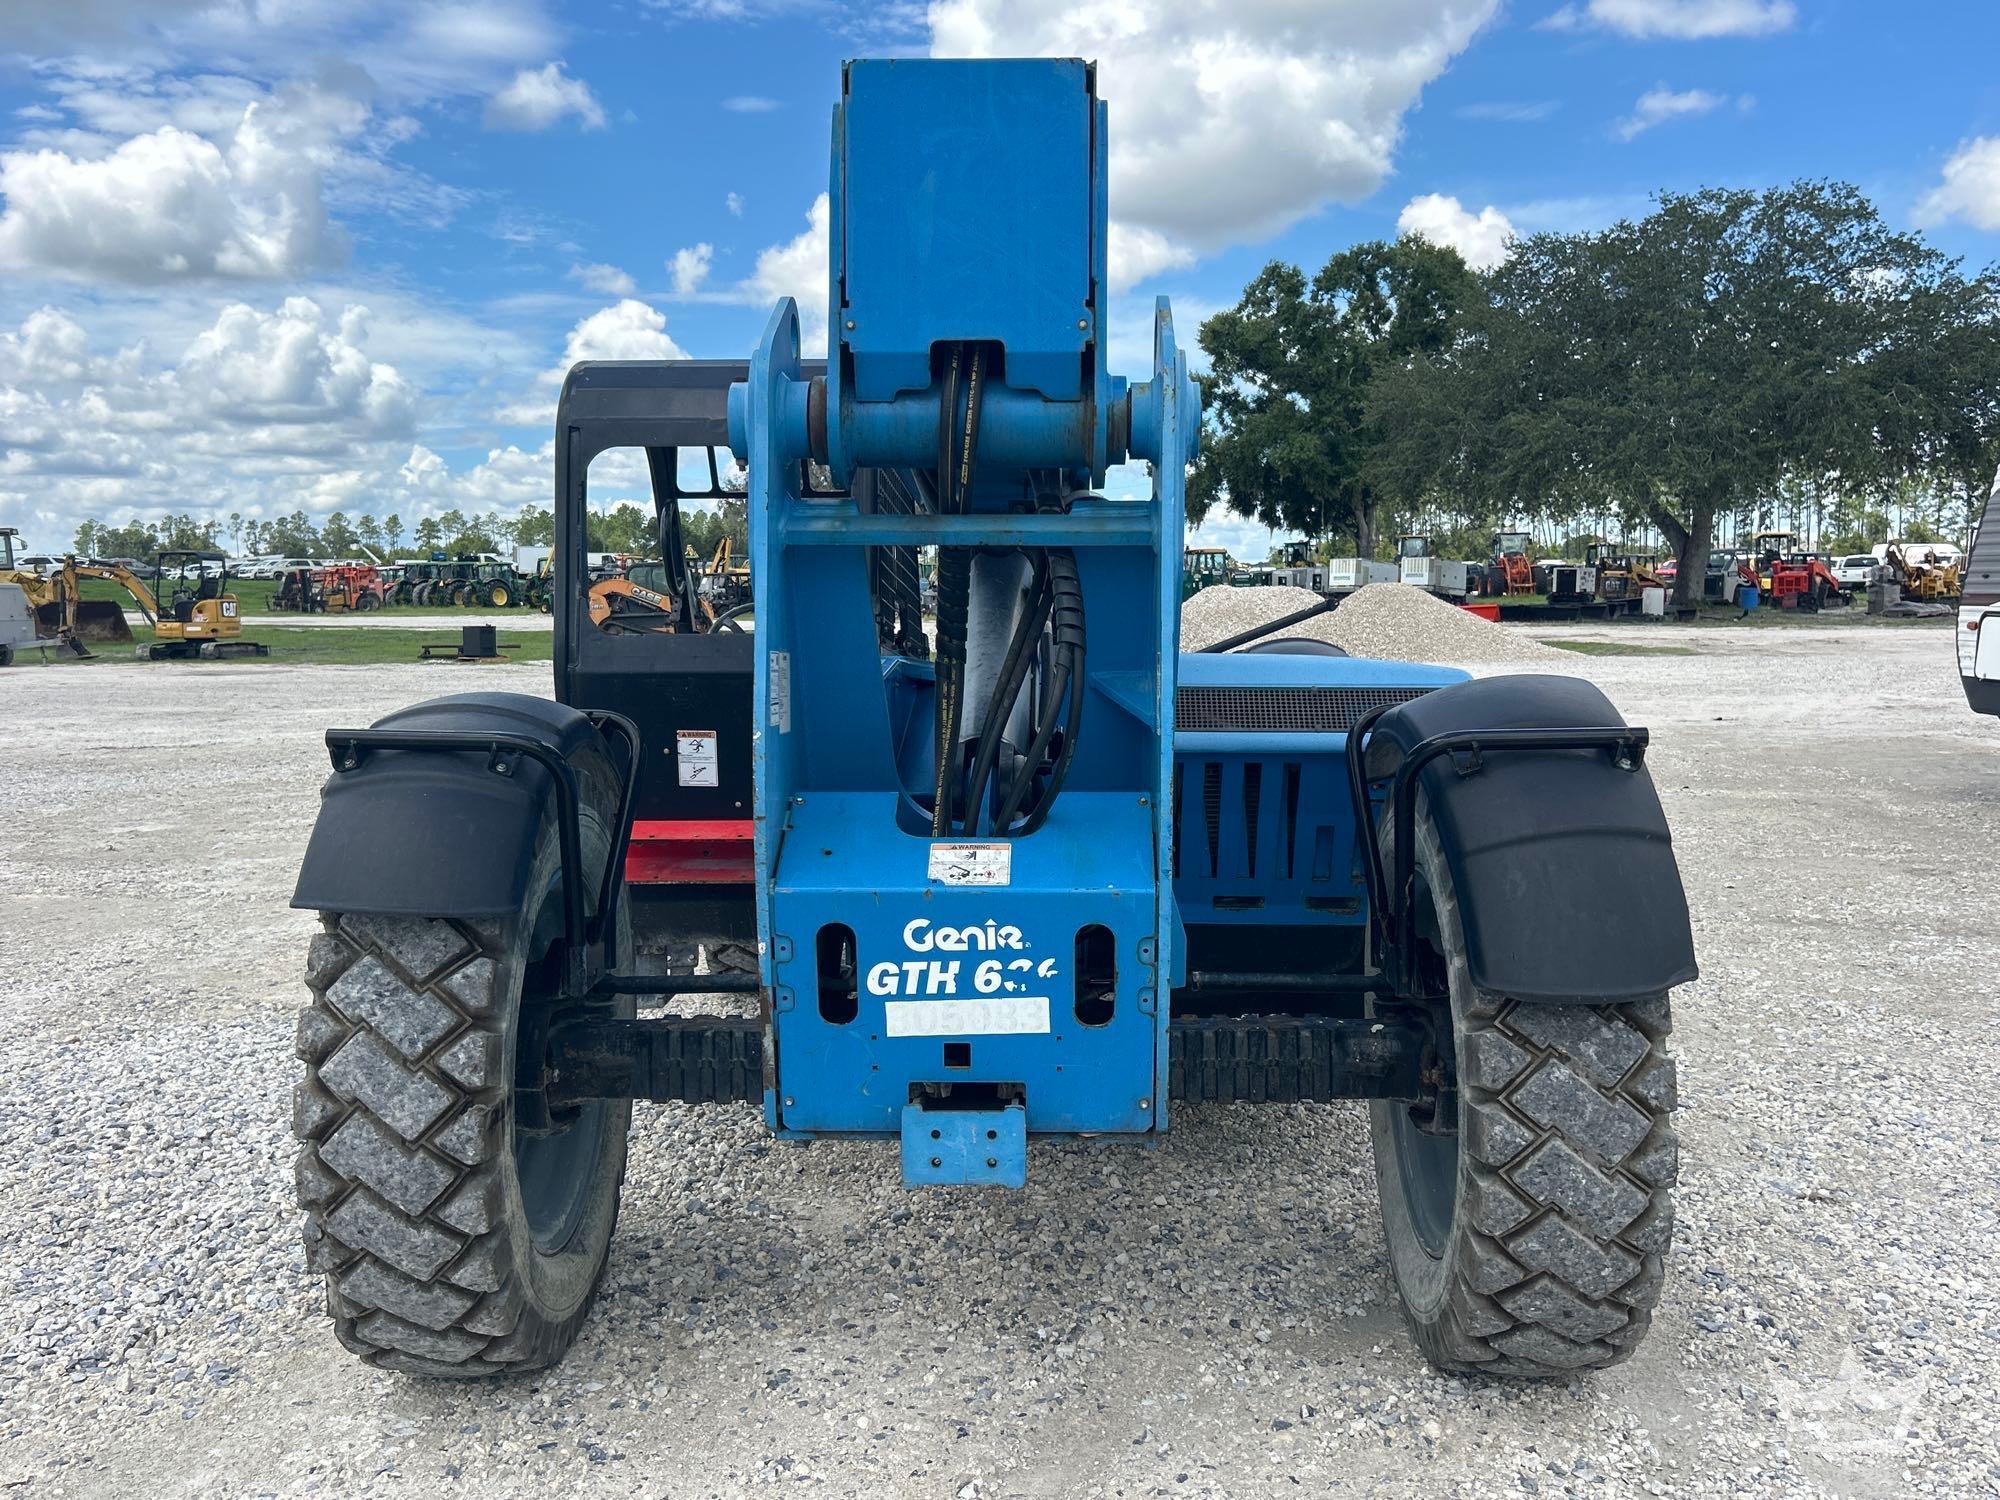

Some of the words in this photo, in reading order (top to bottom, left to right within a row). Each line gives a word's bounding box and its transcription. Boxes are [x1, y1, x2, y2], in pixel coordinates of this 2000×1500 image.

[631, 587, 663, 604] CASE
[223, 602, 237, 616] CAT
[903, 918, 1024, 952] Genie
[866, 960, 960, 996] GTH
